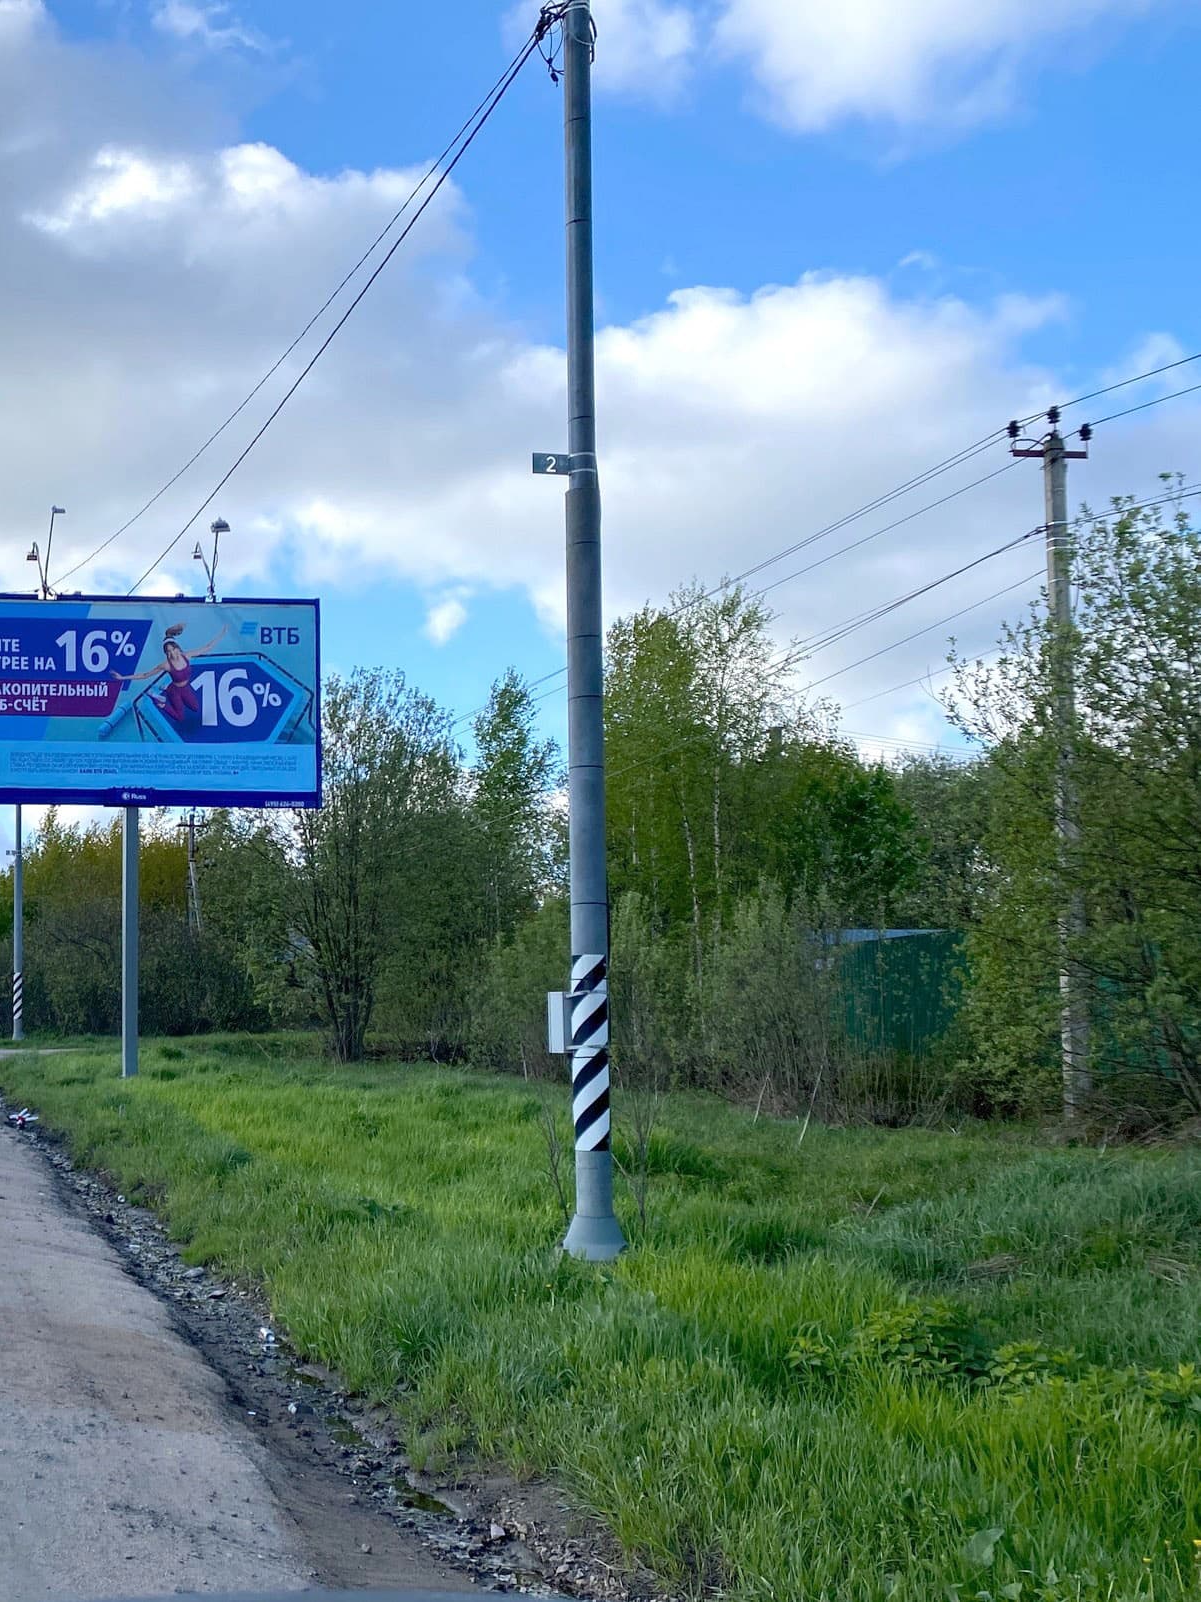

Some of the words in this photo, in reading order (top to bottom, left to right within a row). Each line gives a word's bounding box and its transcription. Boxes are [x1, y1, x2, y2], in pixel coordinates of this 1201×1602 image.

[545, 456, 557, 473] 2
[34, 656, 57, 671] НА
[55, 630, 136, 673] 16%
[259, 626, 301, 646] ВТБ
[190, 668, 283, 727] 16%
